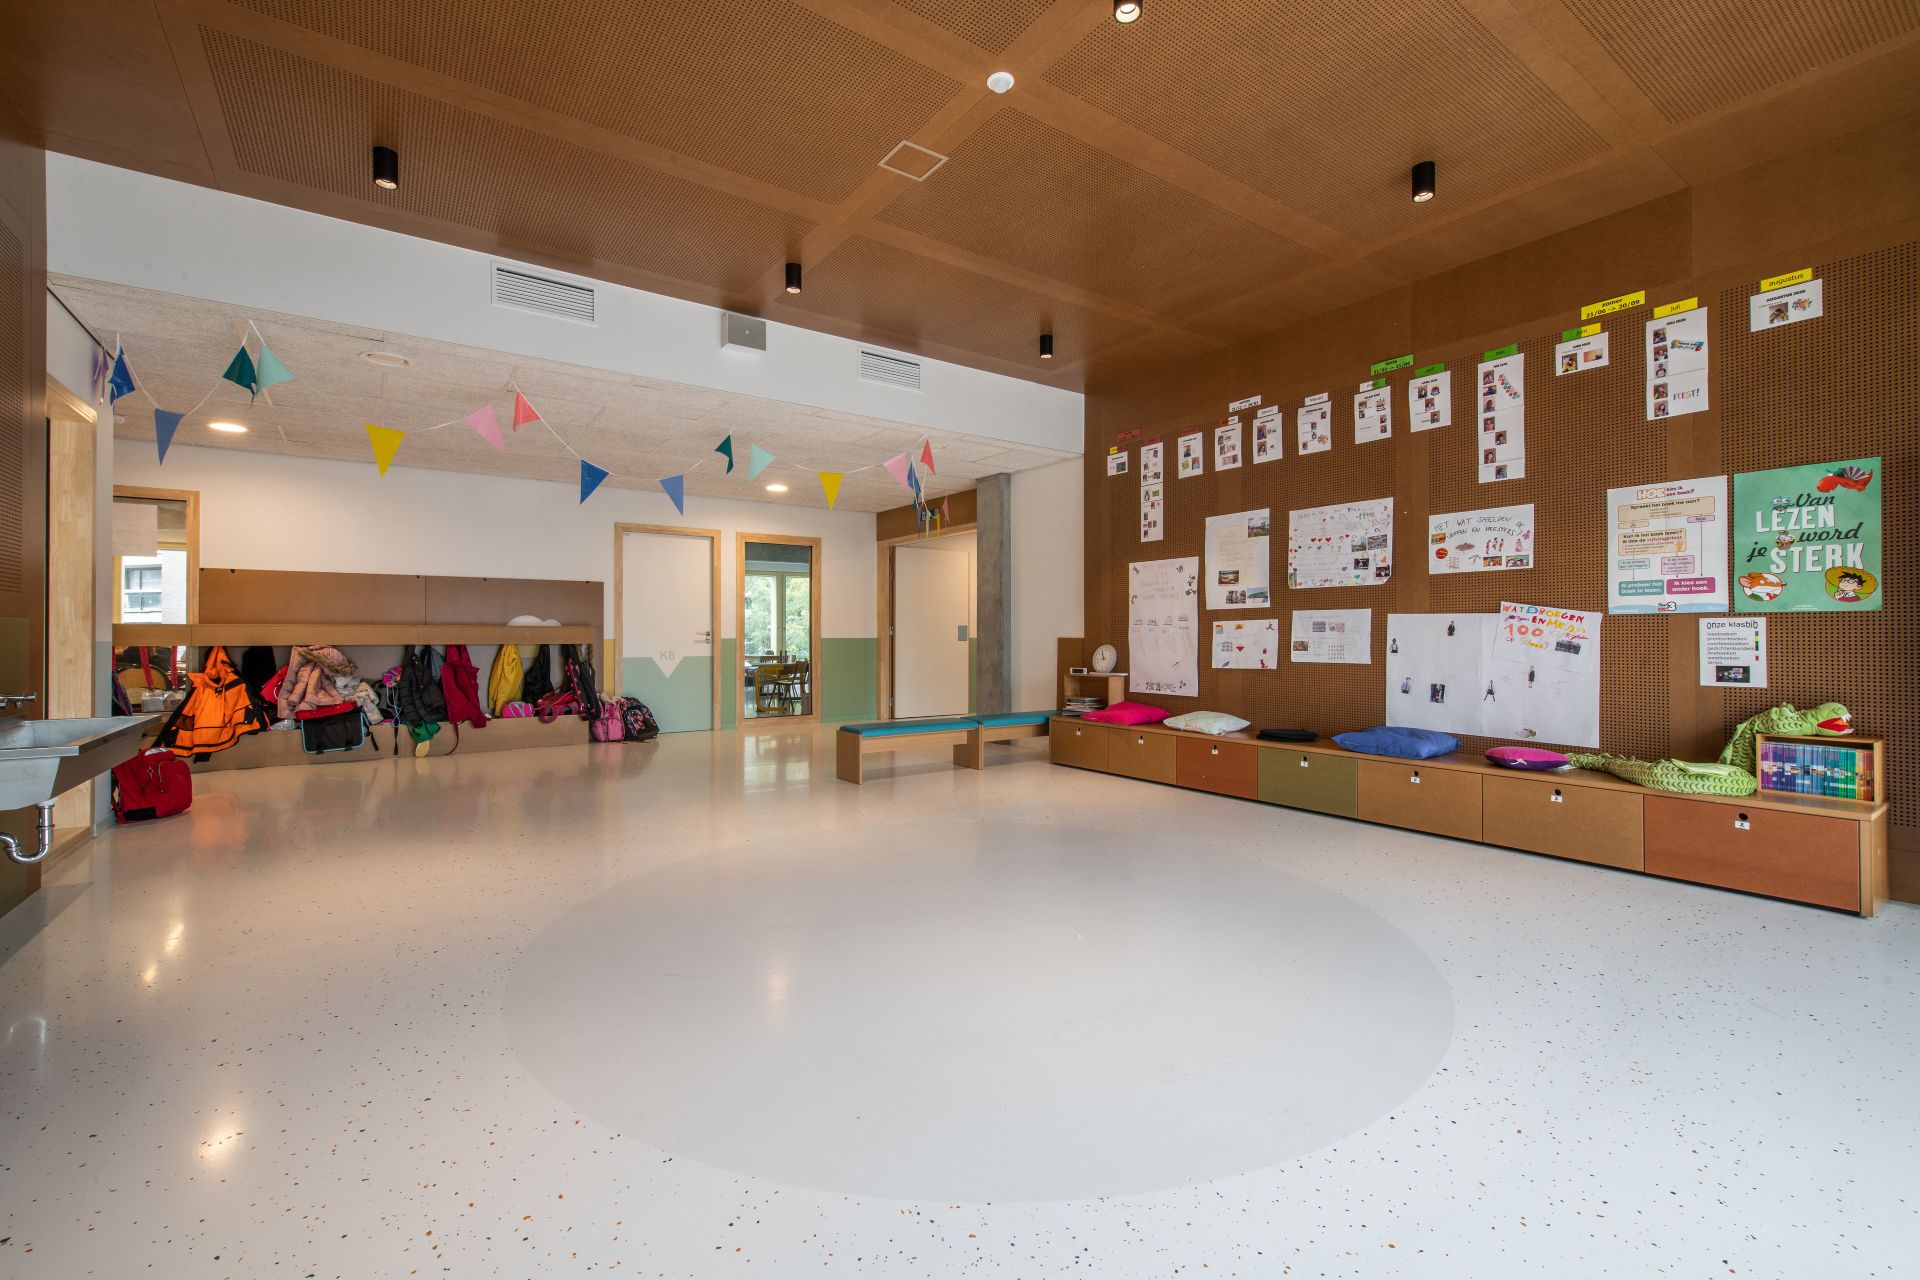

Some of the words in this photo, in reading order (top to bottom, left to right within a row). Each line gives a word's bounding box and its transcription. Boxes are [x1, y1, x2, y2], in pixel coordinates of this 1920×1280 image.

[1768, 273, 1804, 287] augustus
[1601, 298, 1623, 308] zomer
[1618, 299, 1640, 309] 20/09
[1670, 304, 1681, 312] juli
[1673, 388, 1700, 401] FEEST!
[1791, 492, 1835, 507] Van
[1434, 521, 1449, 532] MET
[1456, 517, 1473, 526] WAT
[1755, 504, 1835, 533] LEZEN
[1796, 521, 1864, 542] word
[1746, 541, 1768, 562] je
[1770, 542, 1865, 574] STERK
[1502, 604, 1524, 613] WAT
[1526, 606, 1584, 623] DROEGEN
[1531, 615, 1546, 624] EN
[1504, 623, 1545, 640] 100
[1706, 621, 1726, 630] onze
[1728, 620, 1758, 629] klasbib
[660, 649, 676, 661] K8
